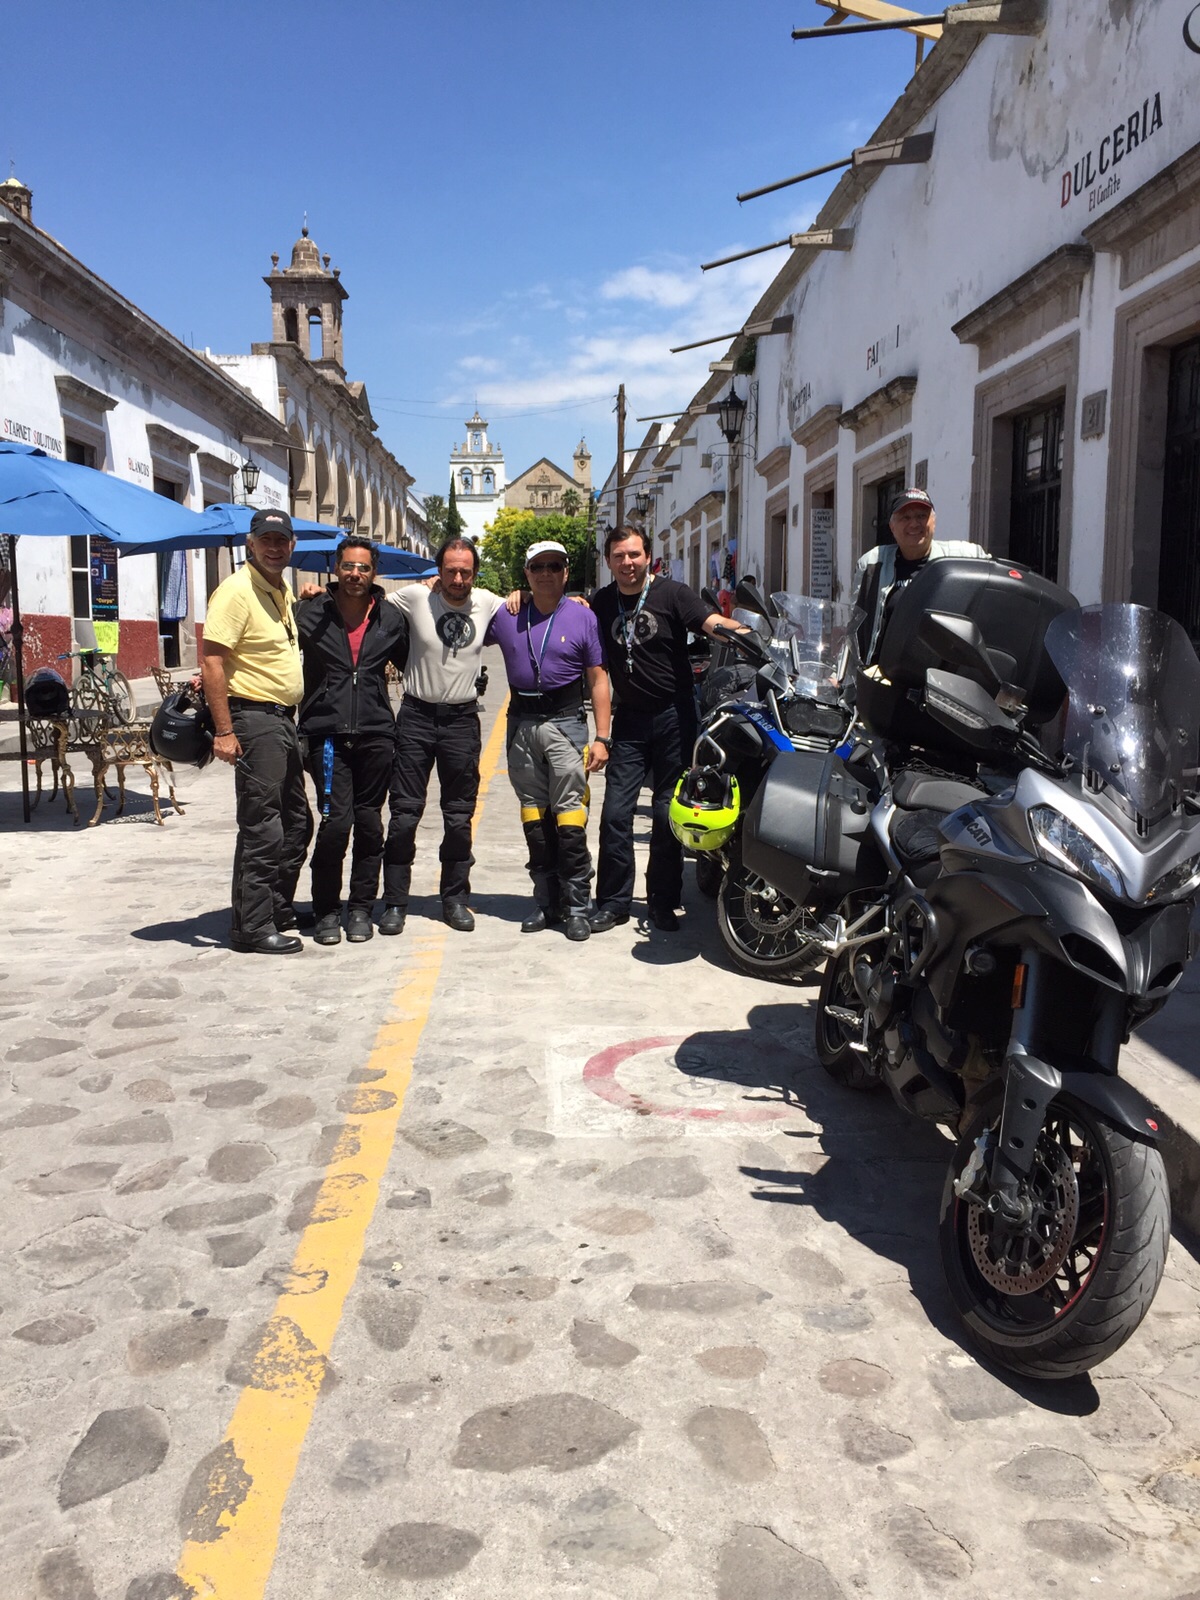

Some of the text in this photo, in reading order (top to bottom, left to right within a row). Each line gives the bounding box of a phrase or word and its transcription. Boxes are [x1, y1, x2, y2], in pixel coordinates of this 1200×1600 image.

[1089, 189, 1096, 212] El
[4, 418, 62, 454] STARNET SOLUTIONS
